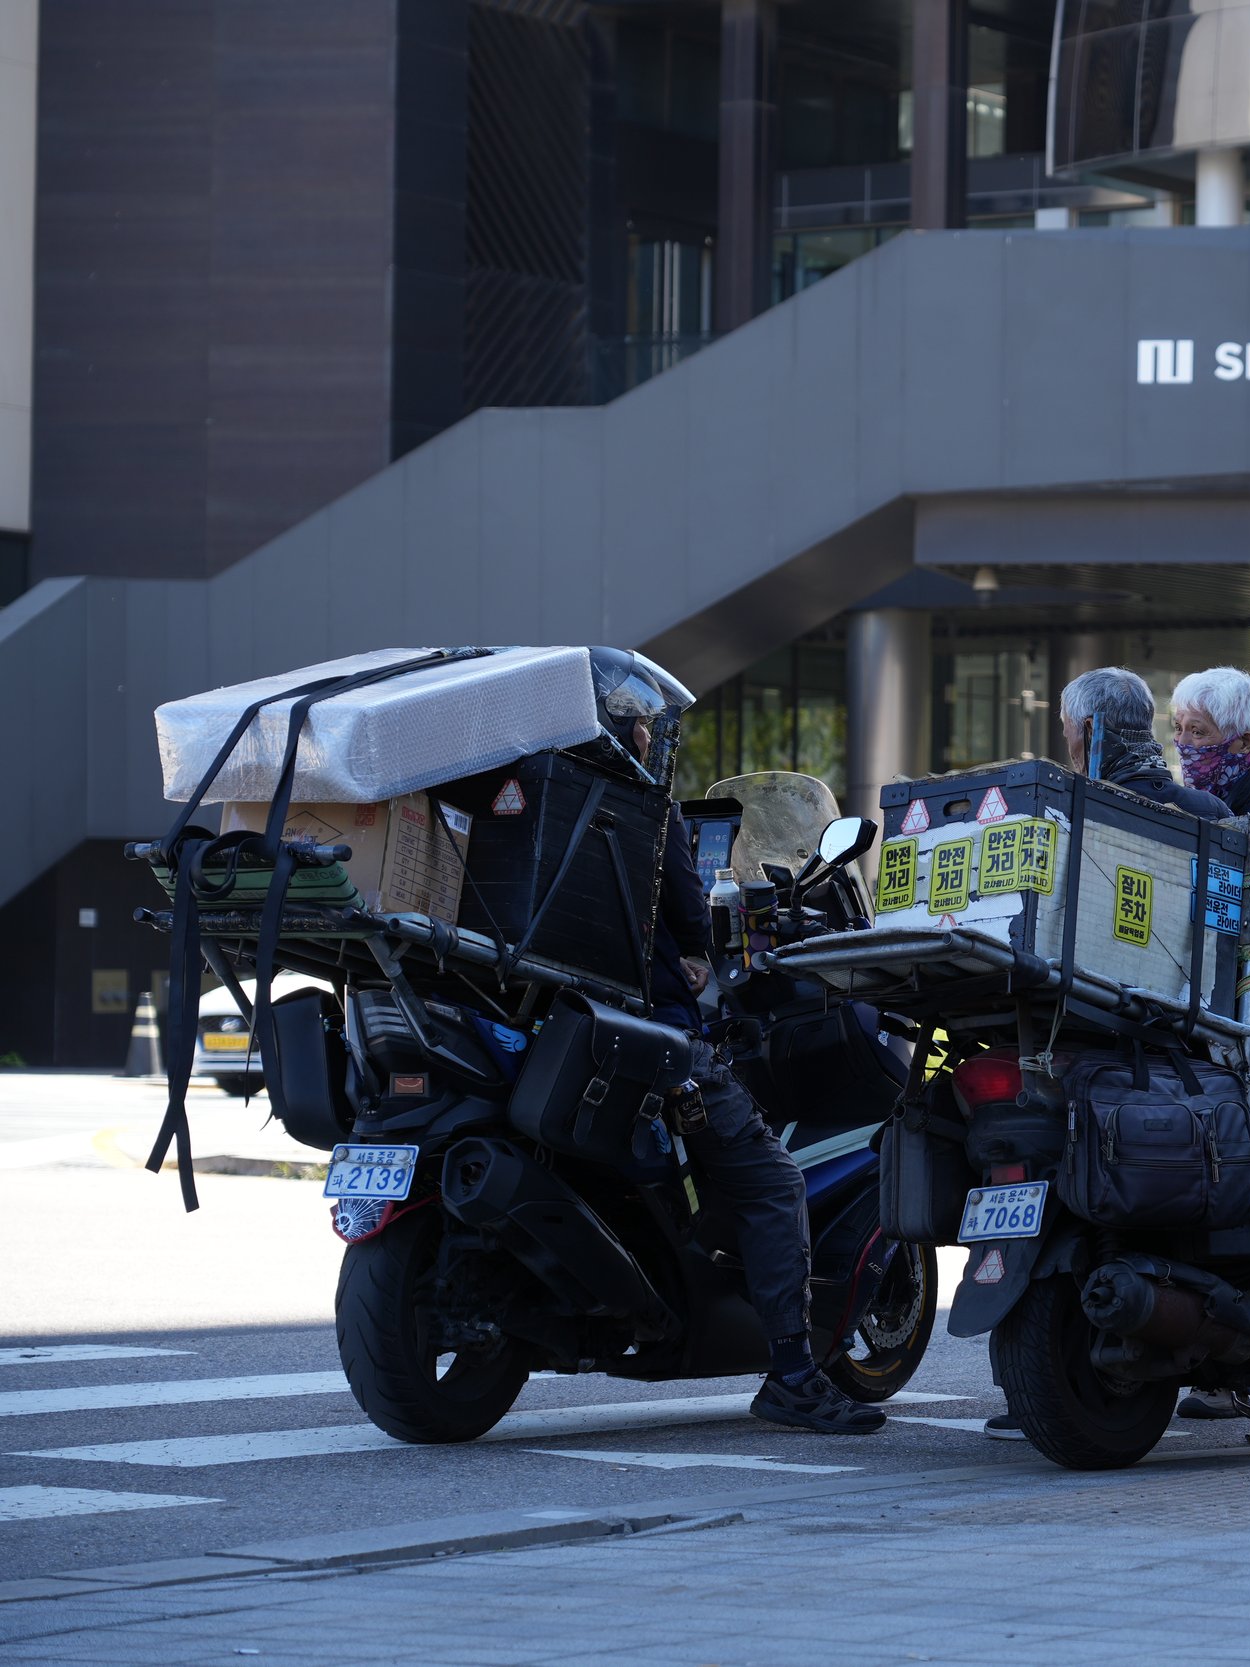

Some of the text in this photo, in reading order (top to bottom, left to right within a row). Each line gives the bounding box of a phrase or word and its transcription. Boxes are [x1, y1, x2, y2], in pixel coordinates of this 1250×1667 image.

[988, 828, 1017, 851] 안전
[1022, 825, 1051, 848] 안전
[886, 845, 911, 868] 안전
[938, 846, 966, 869] 안전
[985, 851, 1014, 874] 거리
[1020, 847, 1049, 870] 거리
[883, 868, 910, 891] 거리
[935, 868, 964, 892] 거리
[983, 877, 1014, 890] 감사합니다
[1121, 874, 1147, 900] 잠시
[1218, 881, 1241, 900] 라이더
[882, 895, 909, 907] 감사합니다
[933, 896, 962, 908] 감사합니다
[1120, 898, 1147, 923] 주차
[1216, 915, 1239, 932] 라이더
[357, 1151, 374, 1164] 서울
[332, 1166, 406, 1190] 파 2139
[989, 1189, 1028, 1204] 서울 용산
[966, 1204, 1036, 1232] 차 7068
